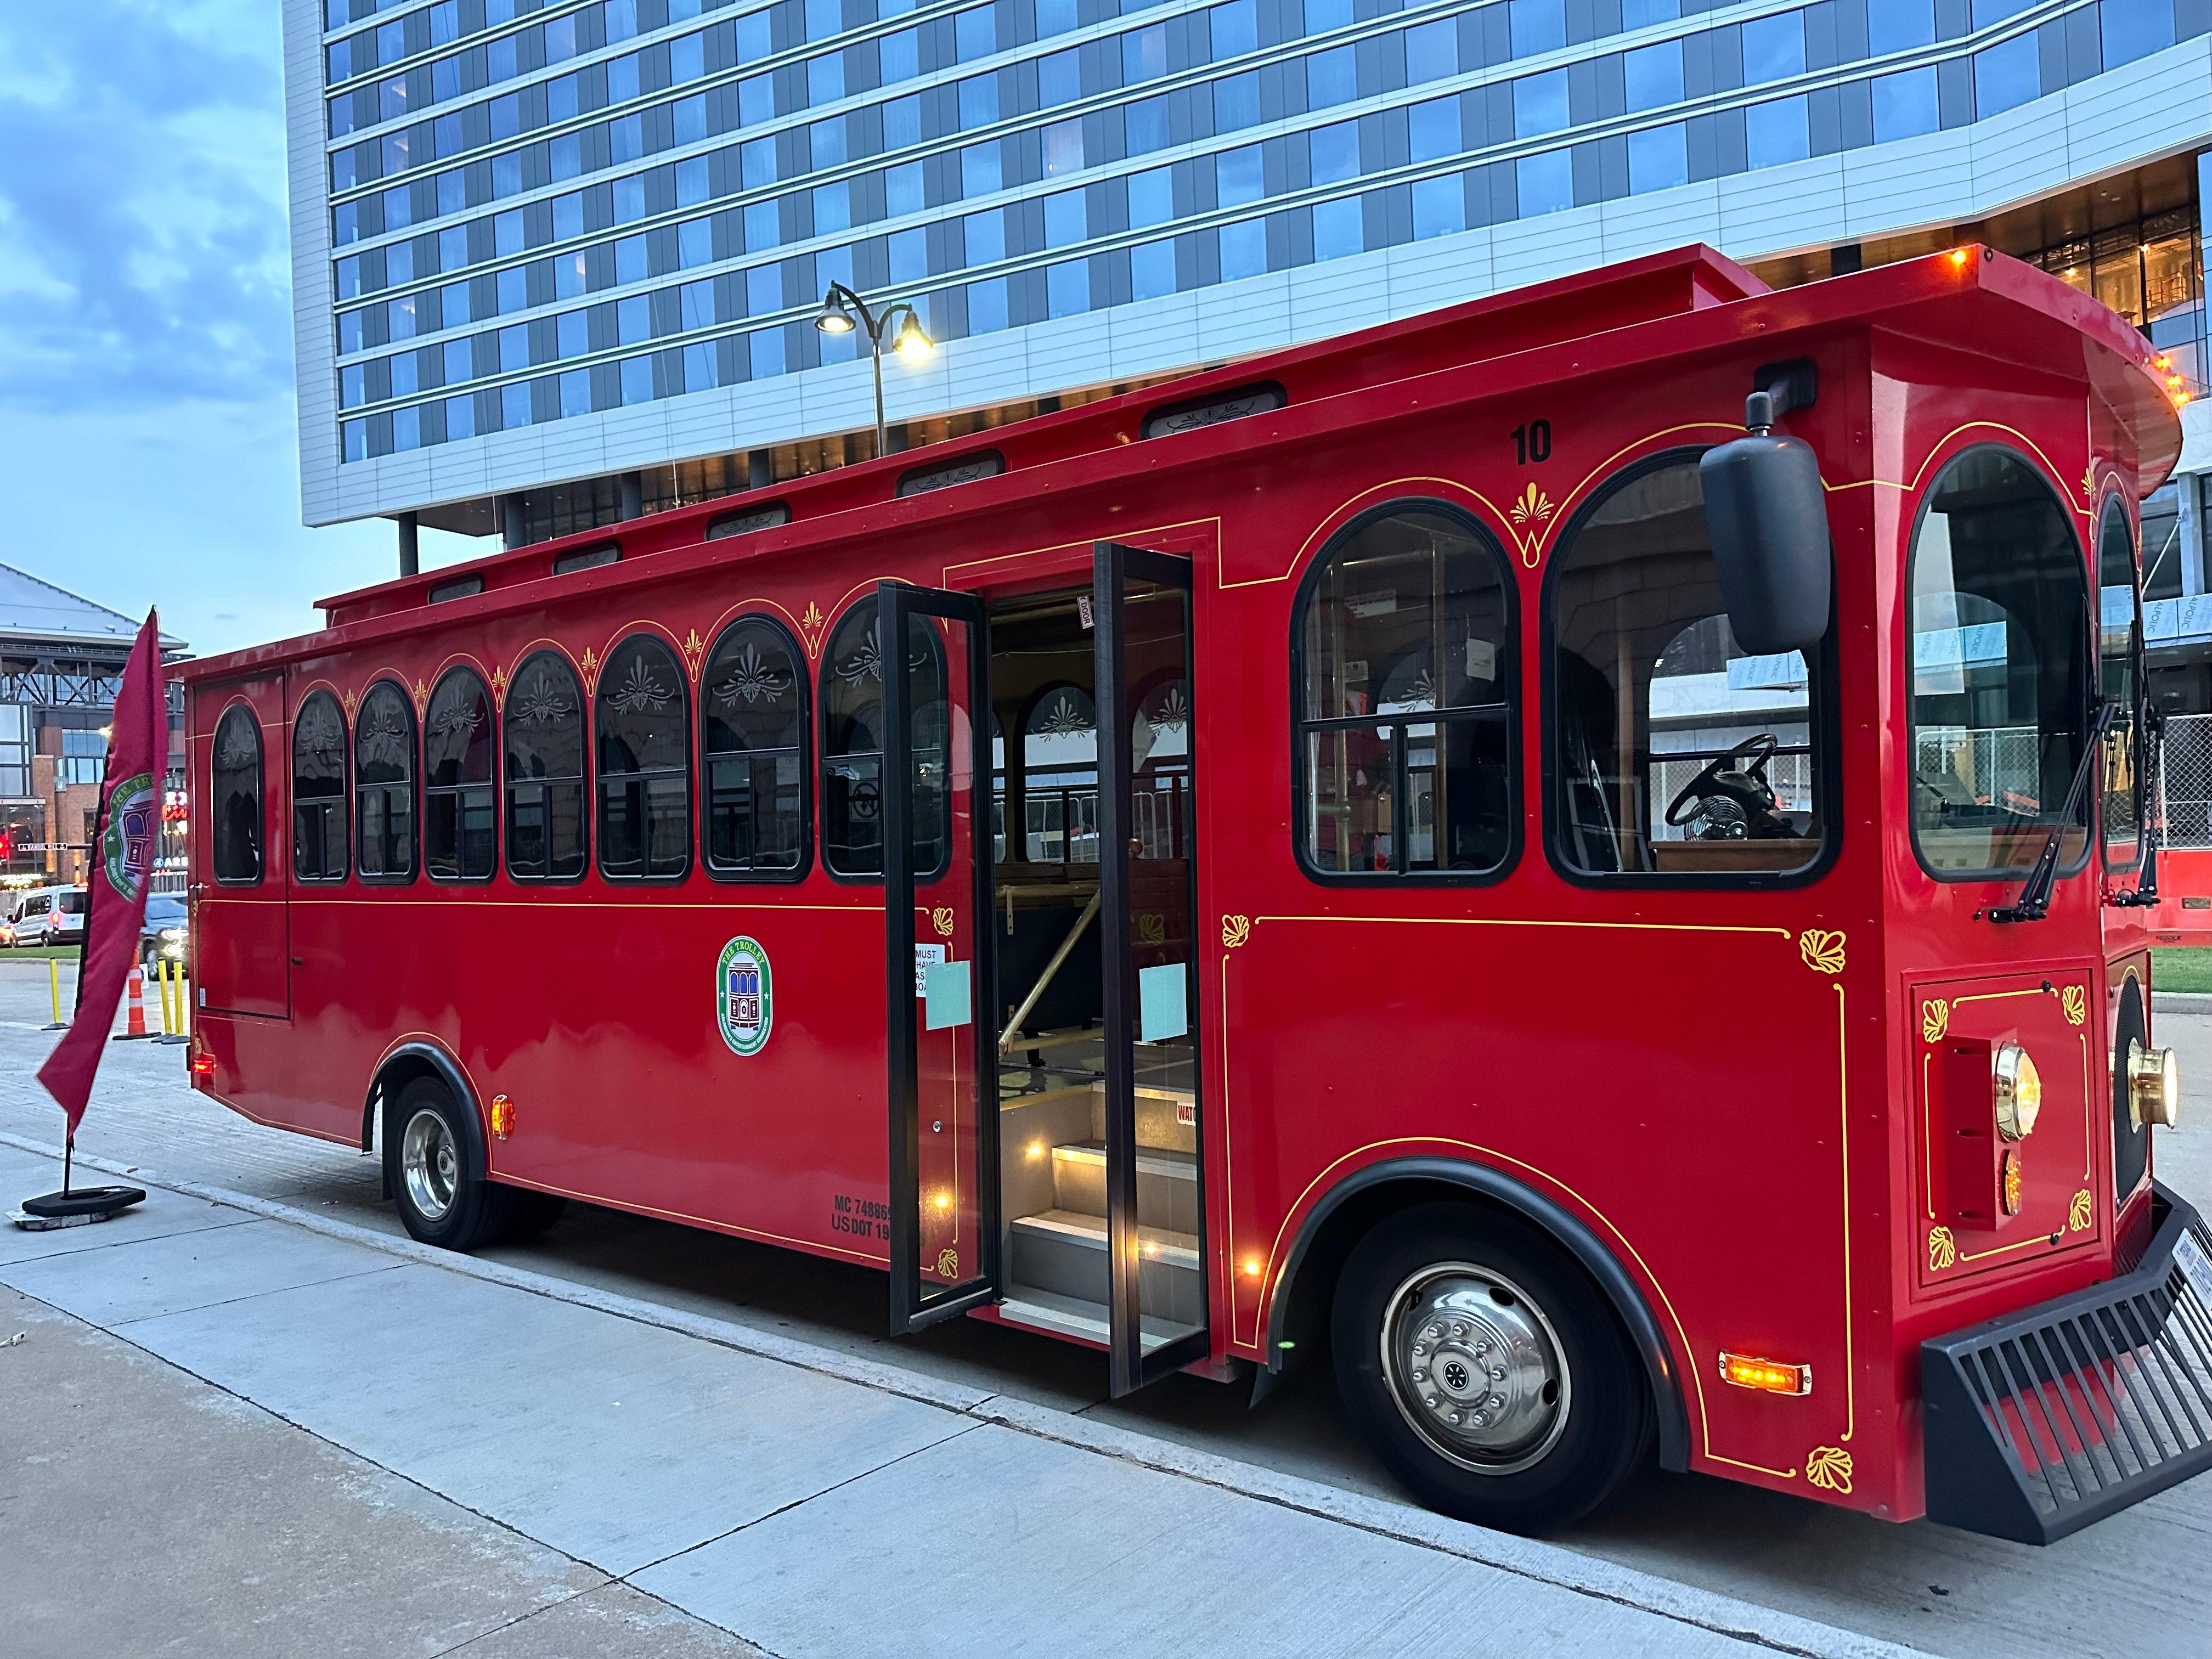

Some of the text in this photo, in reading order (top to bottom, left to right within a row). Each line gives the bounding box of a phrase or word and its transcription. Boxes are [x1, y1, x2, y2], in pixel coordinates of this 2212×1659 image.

[1510, 419, 1551, 465] 10
[1081, 602, 1091, 625] DOOR
[2147, 601, 2164, 634] ALPOLIC
[2181, 596, 2199, 630] ALPOLIC
[722, 941, 765, 964] THE TROLLEY
[916, 950, 936, 959] MUST
[834, 1195, 851, 1213] MC
